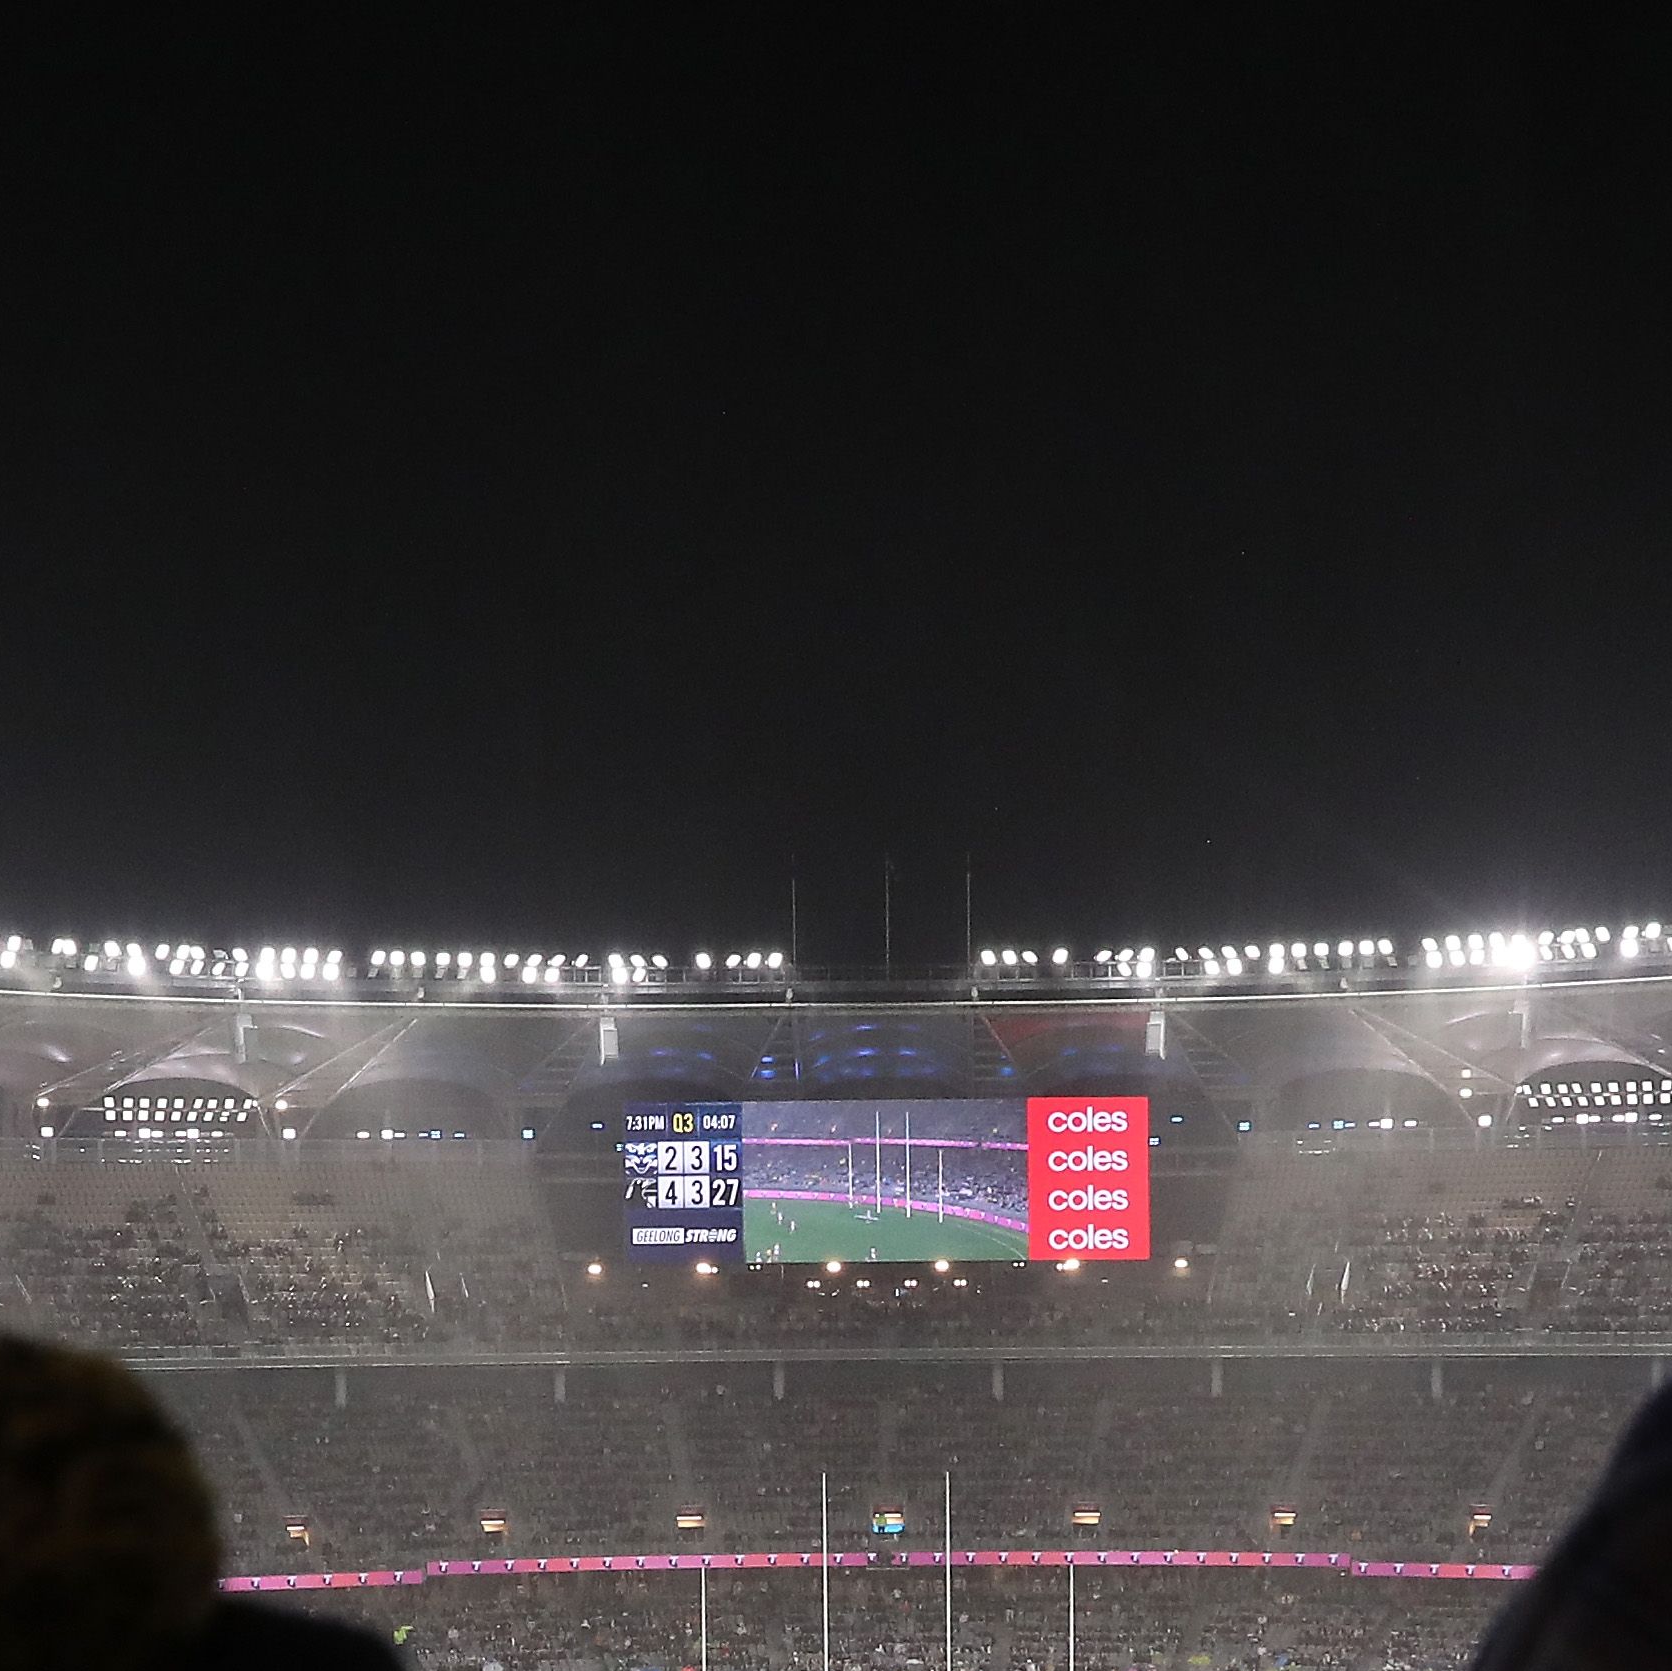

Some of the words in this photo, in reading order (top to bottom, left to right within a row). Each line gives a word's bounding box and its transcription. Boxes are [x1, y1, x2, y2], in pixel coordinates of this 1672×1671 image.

[625, 1115, 665, 1130] 7:31PM
[672, 1113, 694, 1133] Q3
[703, 1115, 736, 1129] 04:07
[1047, 1106, 1128, 1132] coles
[665, 1146, 677, 1170] 2
[691, 1146, 703, 1170] 3
[713, 1144, 737, 1171] 15
[1048, 1145, 1129, 1171] coles
[665, 1180, 677, 1204] 4
[691, 1180, 703, 1204] 3
[712, 1178, 739, 1206] 27
[1048, 1184, 1129, 1211] coles
[636, 1230, 680, 1242] GEELONG
[1048, 1223, 1129, 1250] coles
